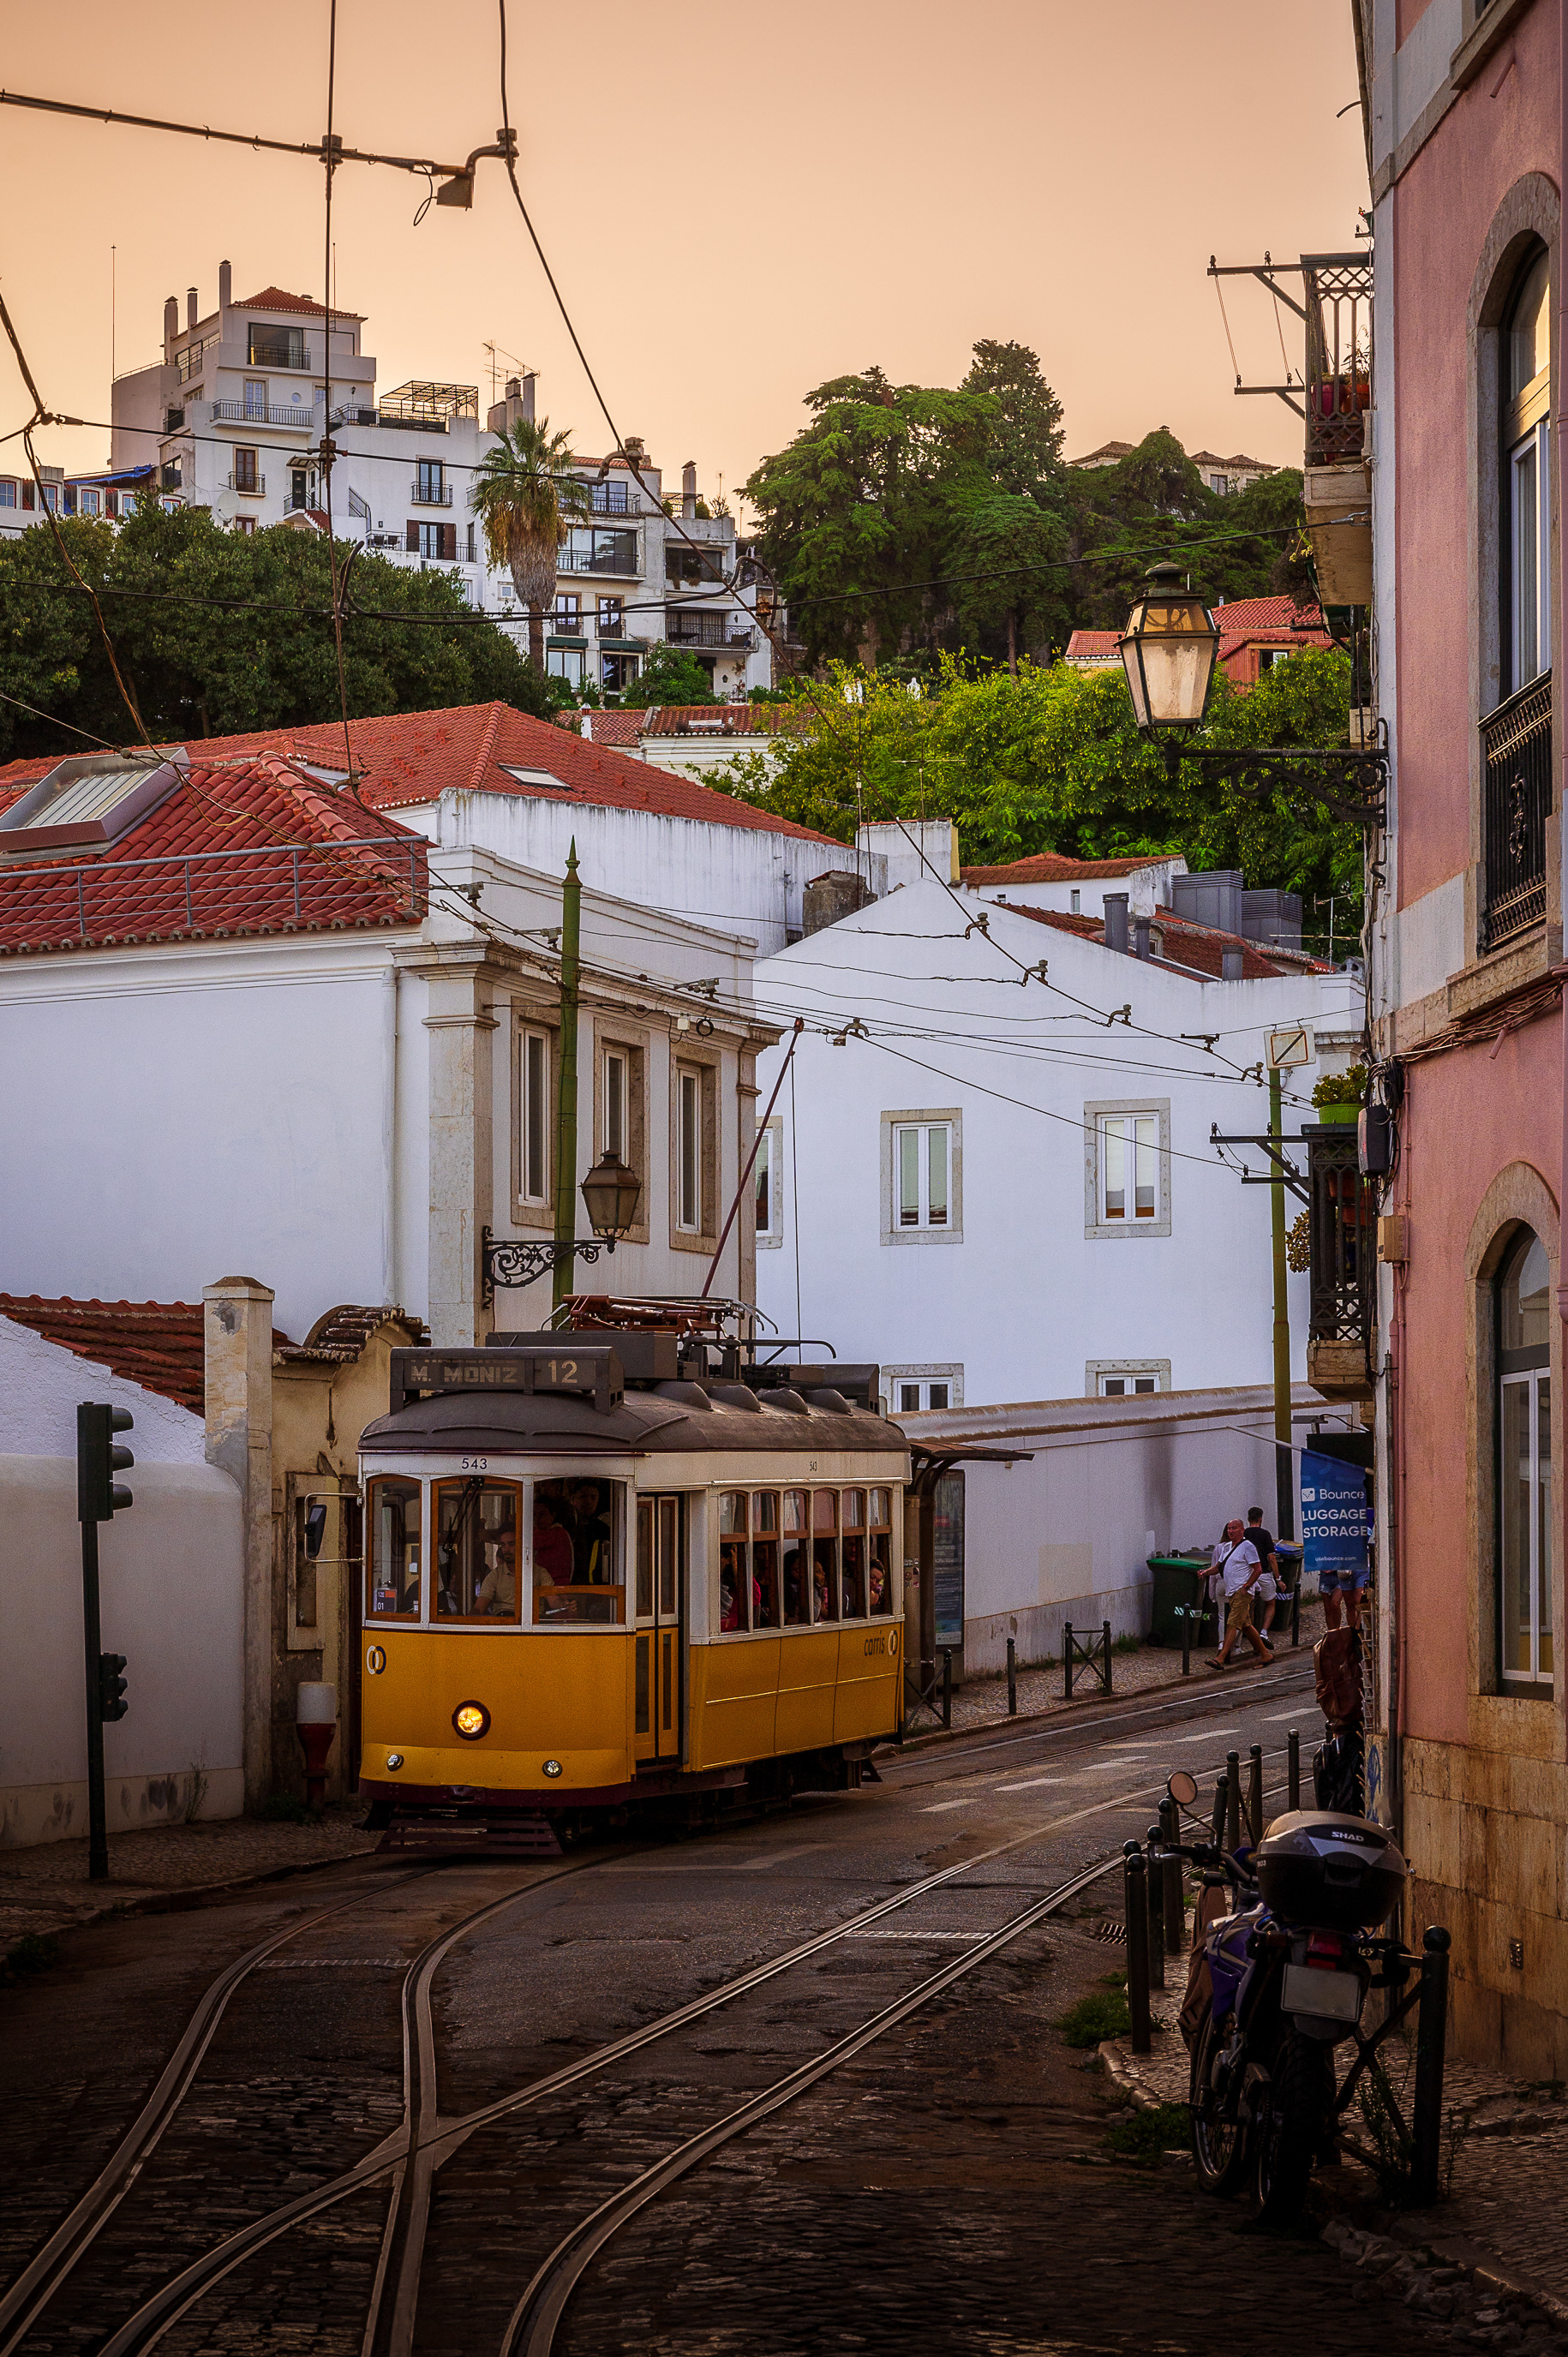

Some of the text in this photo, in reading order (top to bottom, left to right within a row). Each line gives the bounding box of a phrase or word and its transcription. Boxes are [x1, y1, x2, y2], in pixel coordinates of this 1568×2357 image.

[410, 1366, 518, 1384] M. MONIZ
[548, 1360, 578, 1384] 12
[461, 1457, 488, 1470] 543
[1320, 1488, 1365, 1499] Bounce
[1302, 1509, 1367, 1522] LUGGAGE
[1303, 1526, 1368, 1539] STORAGE
[377, 1601, 384, 1611] 01
[864, 1630, 885, 1656] carris
[1331, 1831, 1365, 1842] SHAD
